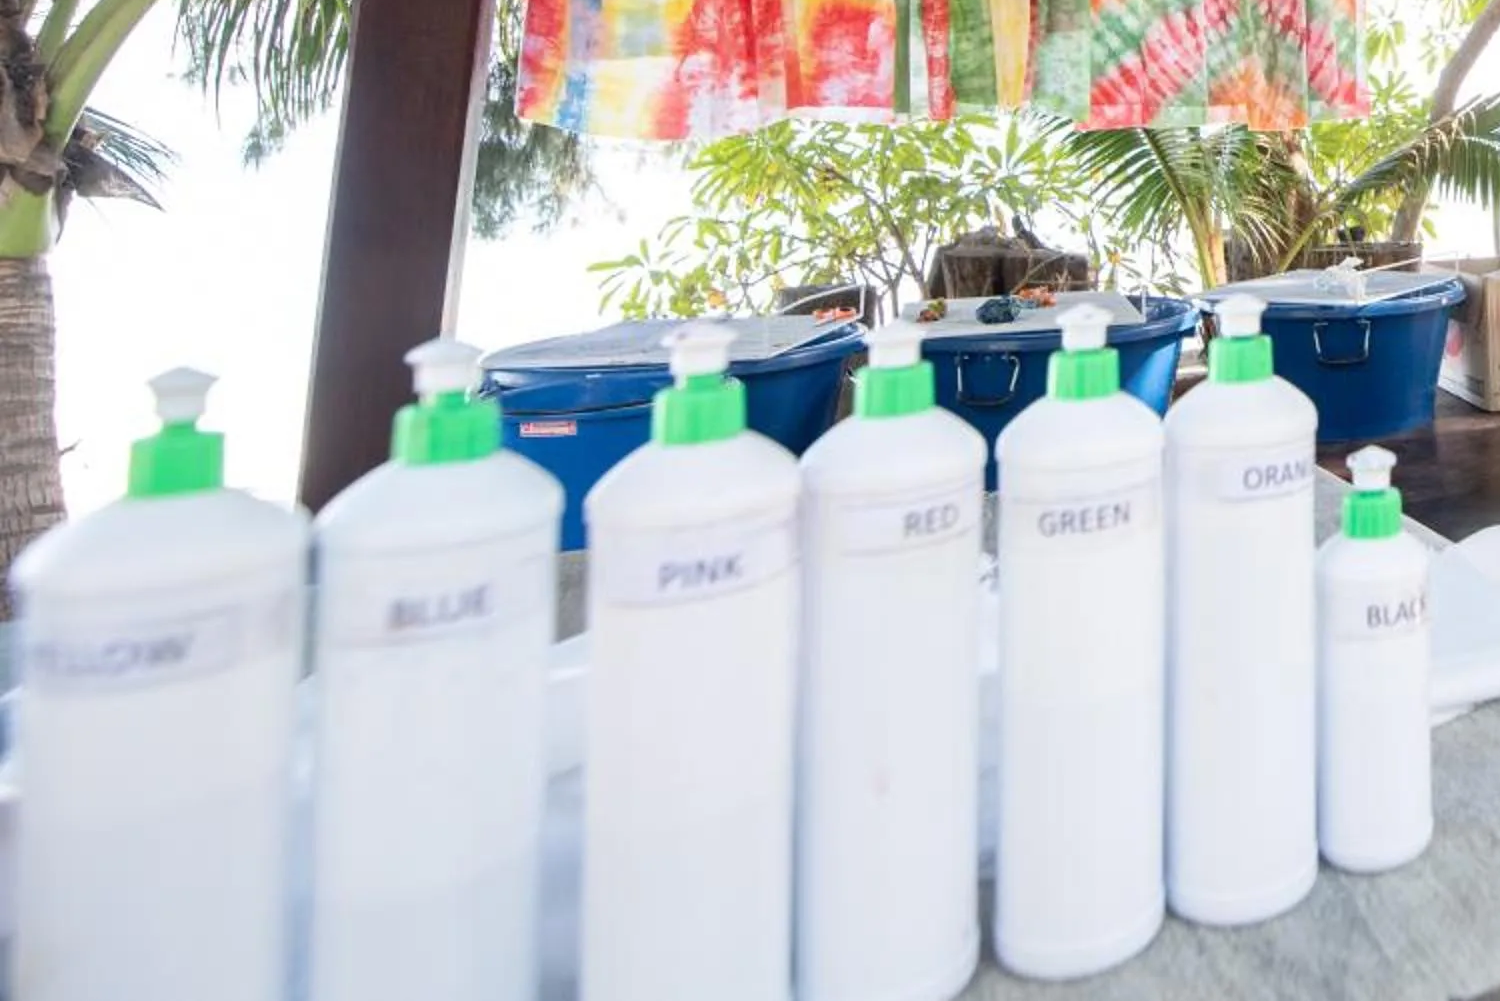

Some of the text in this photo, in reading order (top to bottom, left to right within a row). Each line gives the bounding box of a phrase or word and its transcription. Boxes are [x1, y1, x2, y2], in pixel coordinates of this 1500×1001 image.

[903, 504, 960, 538] RED
[1038, 500, 1130, 537] GREEN
[658, 552, 744, 592] PINK
[386, 582, 494, 631] BLUE
